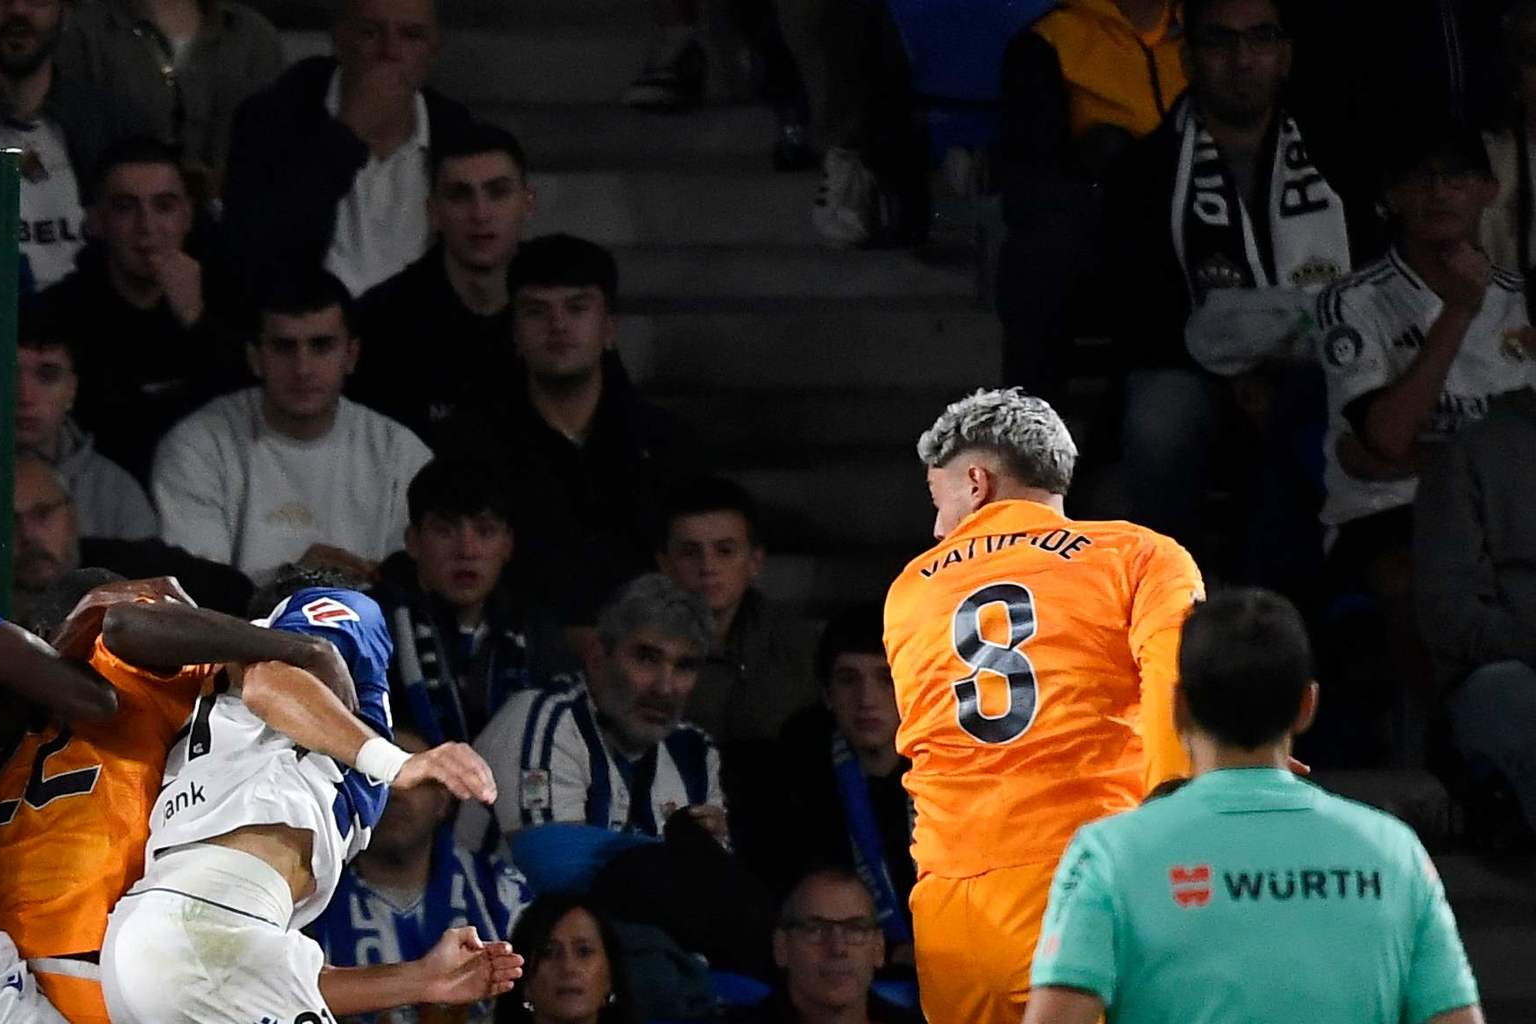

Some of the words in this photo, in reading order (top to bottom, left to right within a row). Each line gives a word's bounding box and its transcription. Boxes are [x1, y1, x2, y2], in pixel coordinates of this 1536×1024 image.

[951, 581, 1039, 745] 8
[163, 781, 207, 823] ank
[1223, 867, 1382, 900] WÜRTH
